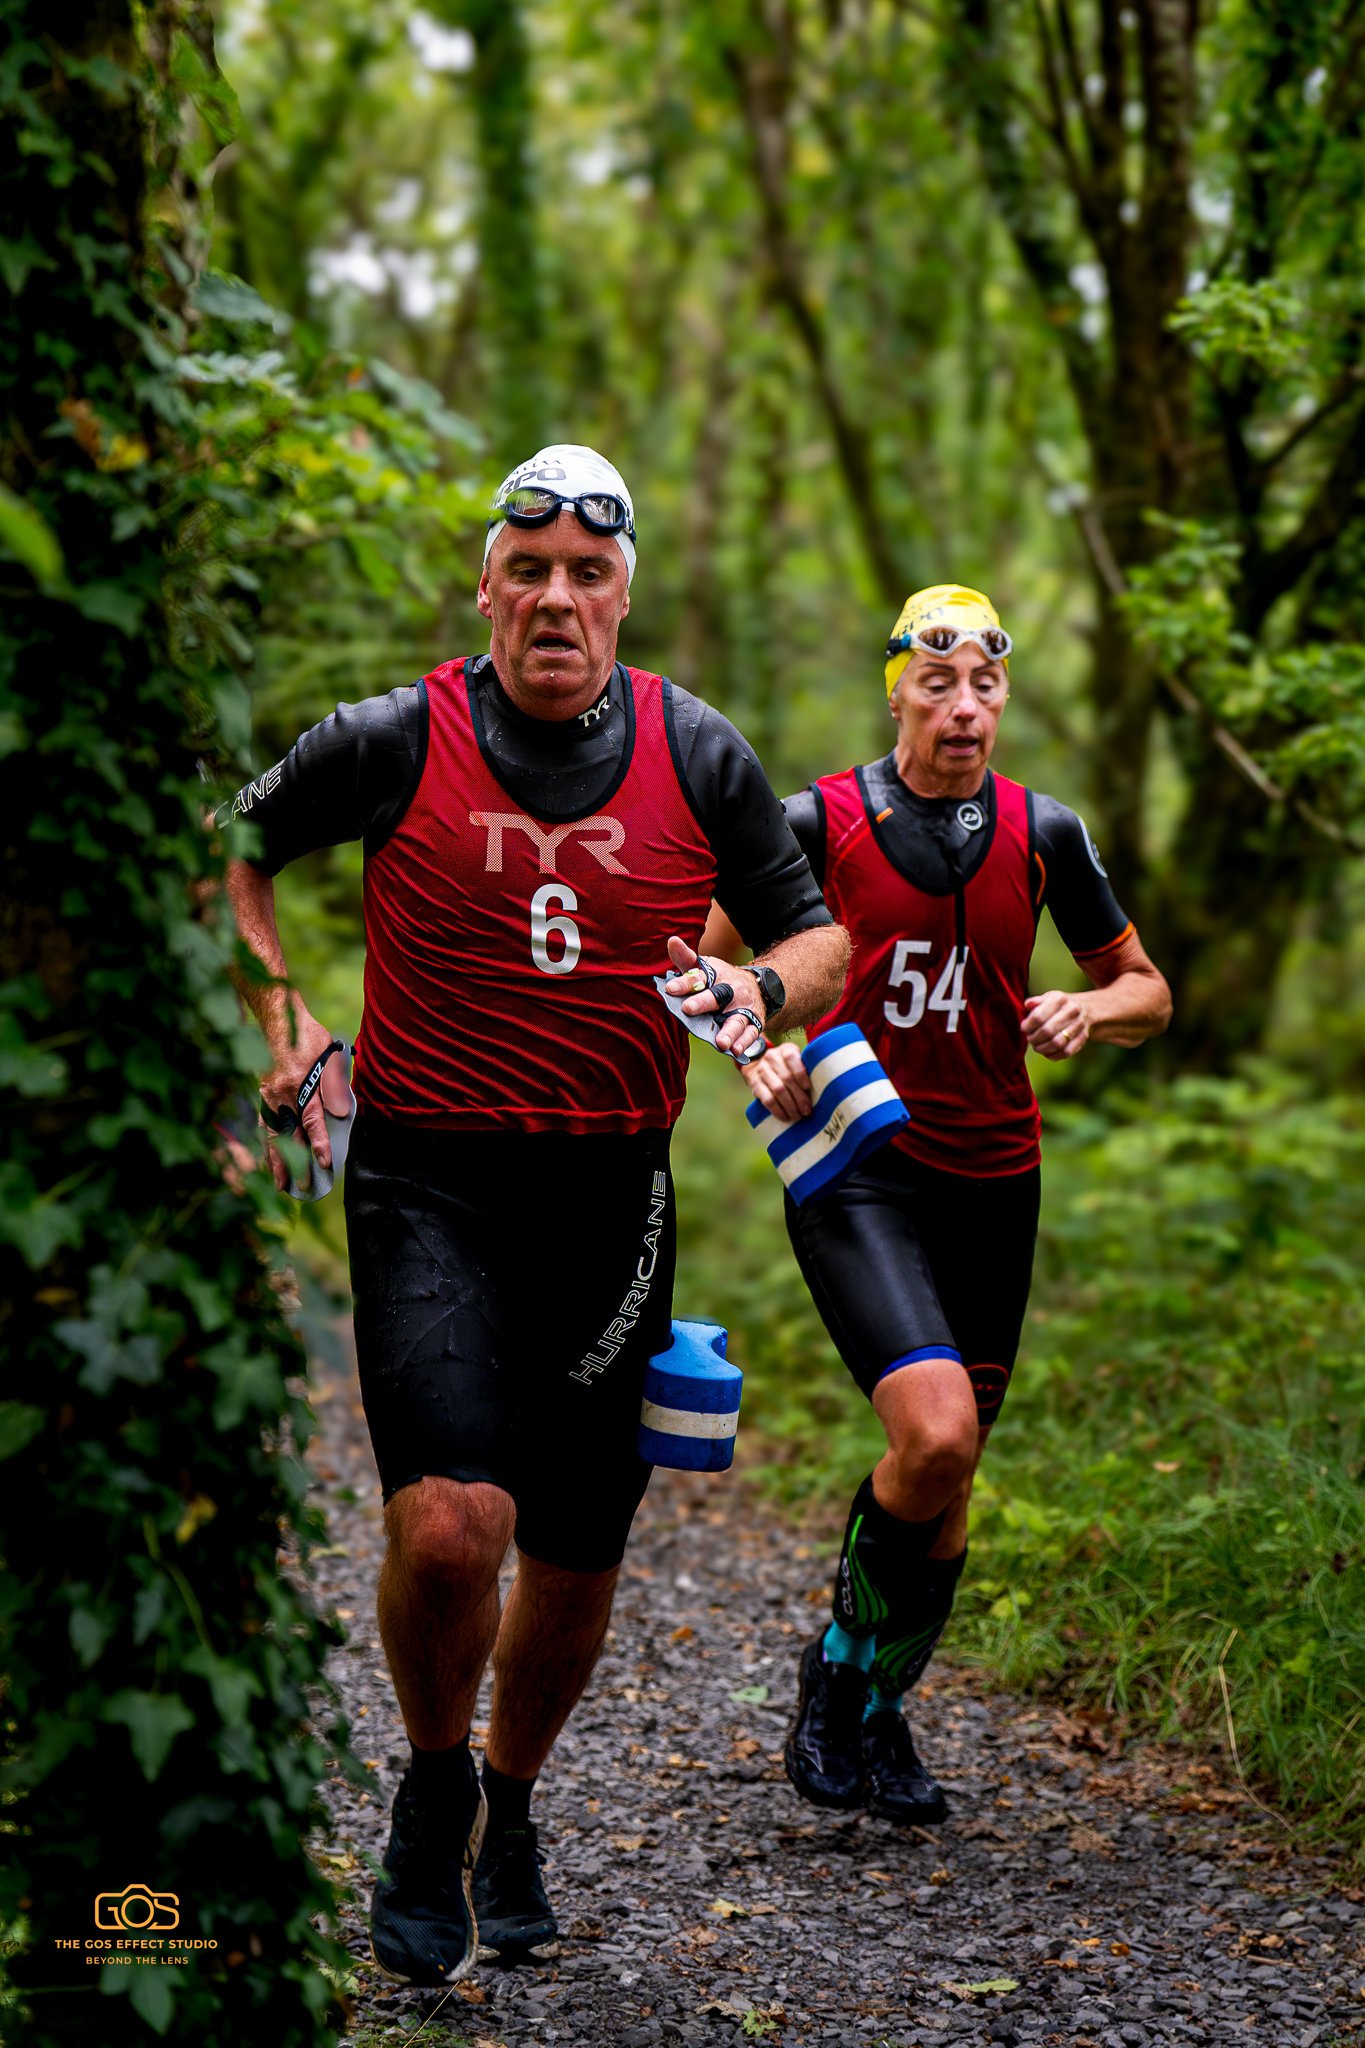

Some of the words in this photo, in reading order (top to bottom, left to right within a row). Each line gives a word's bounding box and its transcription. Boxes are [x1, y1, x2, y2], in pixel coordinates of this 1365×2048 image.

[578, 695, 610, 727] TYR
[468, 810, 630, 875] TYR
[530, 883, 582, 975] 6
[883, 939, 969, 1033] 54
[568, 1170, 666, 1385] HURRICANE
